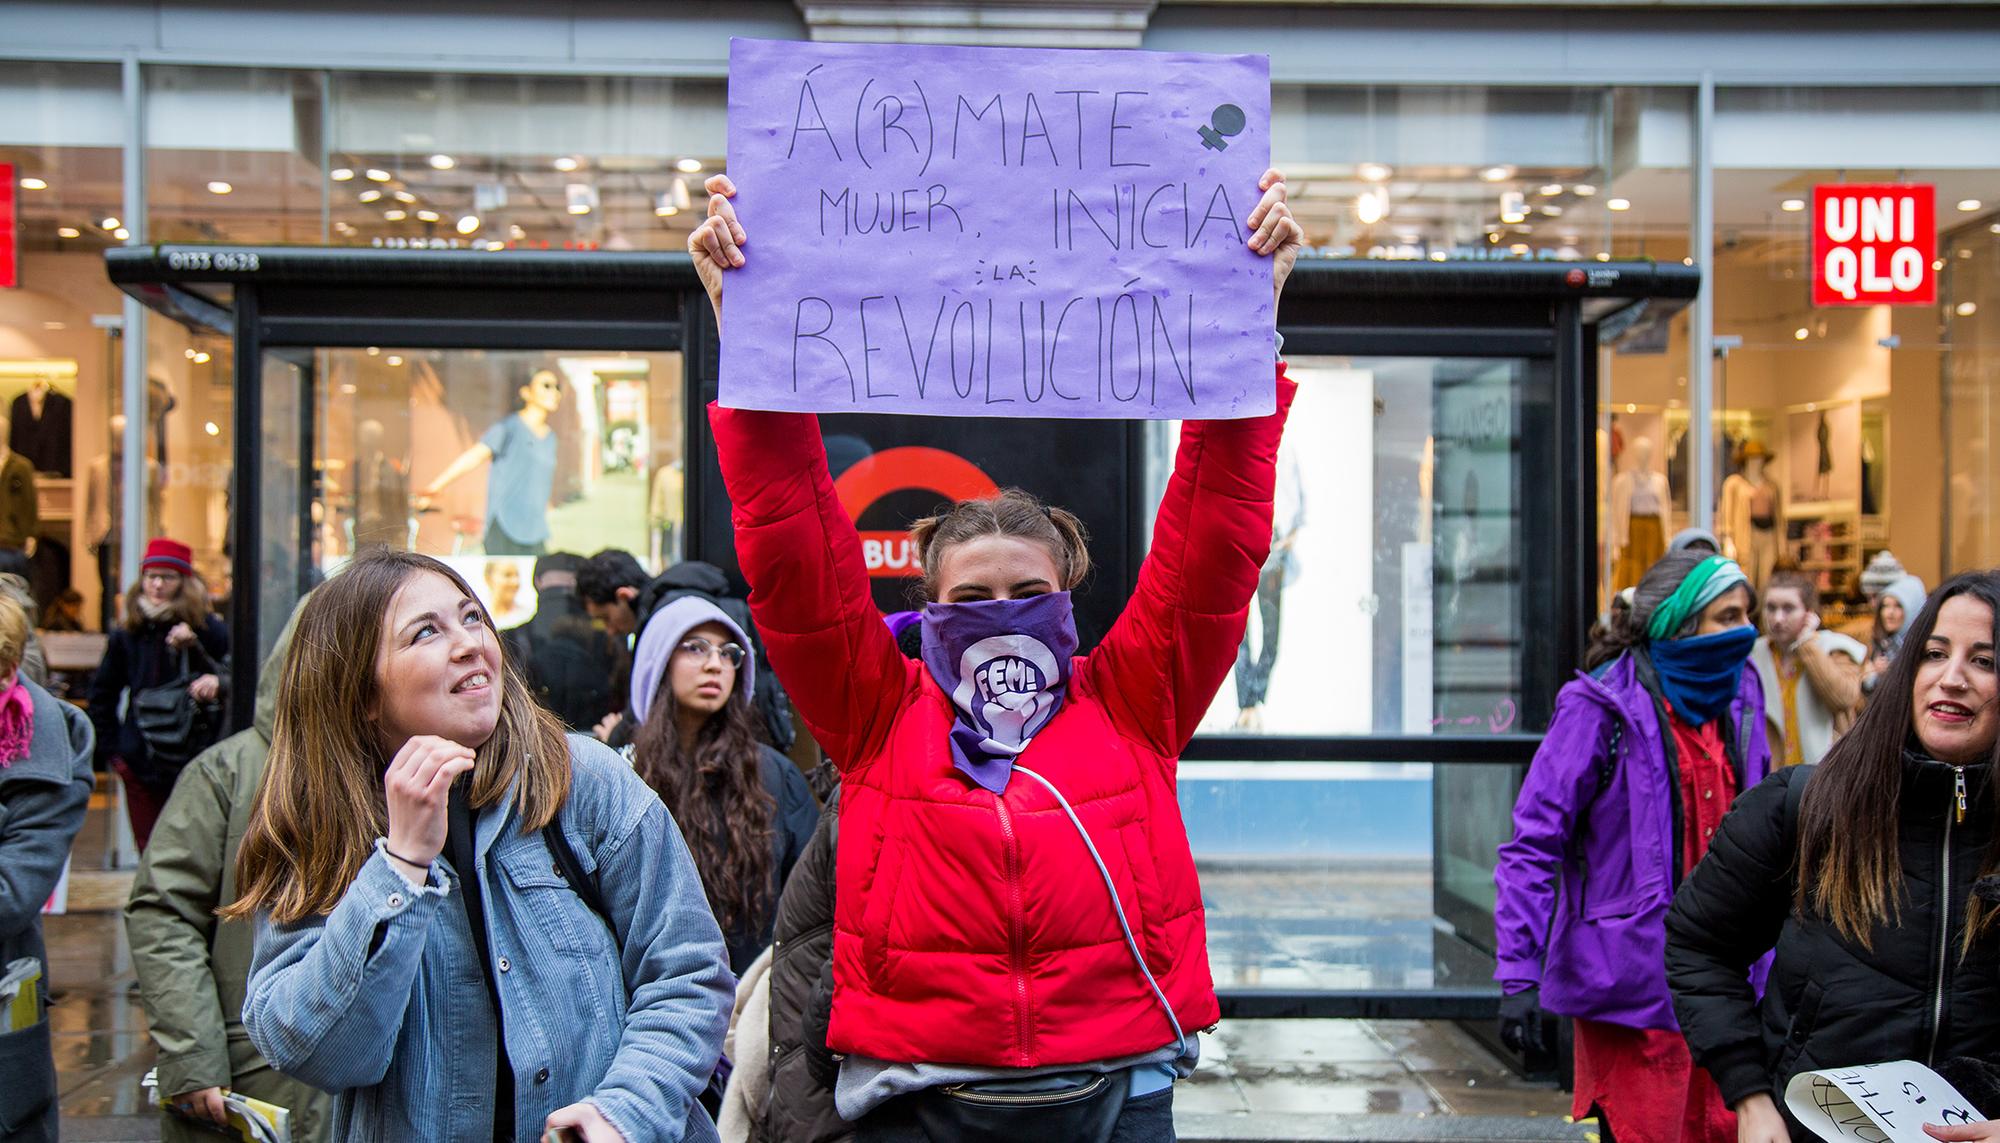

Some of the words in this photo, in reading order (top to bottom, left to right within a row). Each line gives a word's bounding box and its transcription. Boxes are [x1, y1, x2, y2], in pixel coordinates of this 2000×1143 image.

[788, 64, 1150, 176] Á(R)MATE
[820, 184, 981, 239] MUJER,
[1053, 182, 1243, 251] INICIA
[1824, 196, 1915, 243] UNI
[168, 252, 212, 271] 0133
[993, 264, 1026, 281] LA
[1824, 246, 1924, 300] QLO
[793, 276, 1196, 405] REVOLUCIÓN
